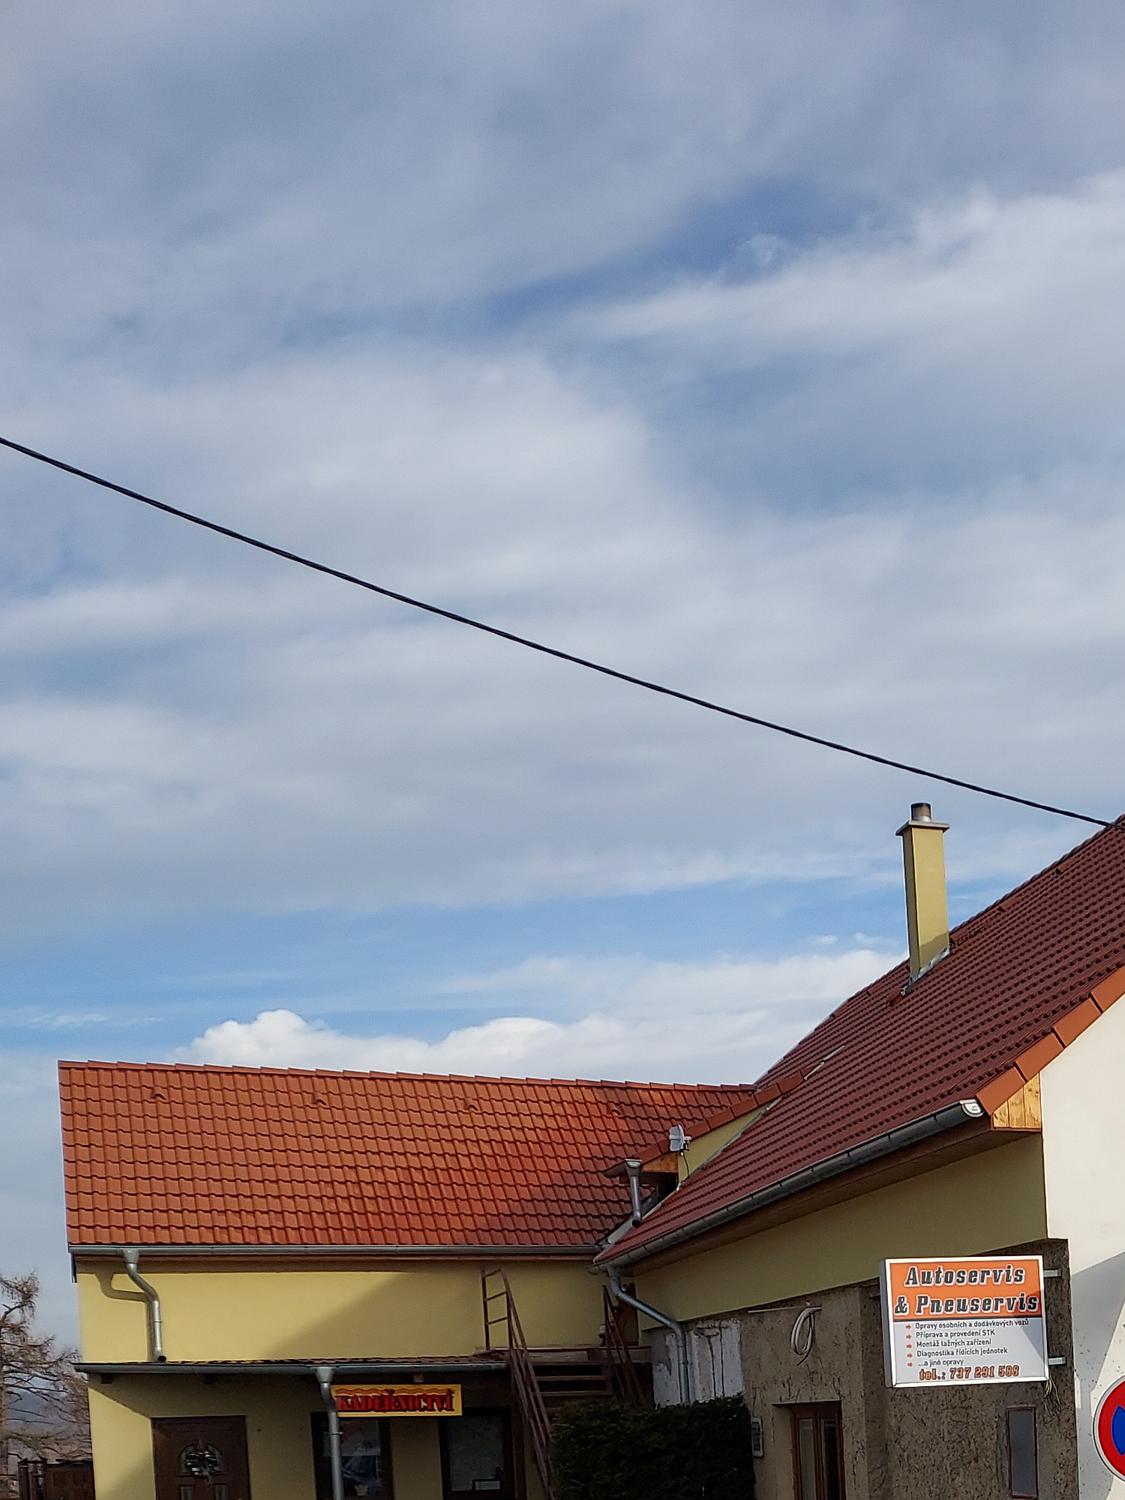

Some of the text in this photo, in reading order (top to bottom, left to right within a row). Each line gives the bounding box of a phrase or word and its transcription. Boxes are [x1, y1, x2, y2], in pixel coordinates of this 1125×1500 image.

[904, 1266, 1025, 1287] Autoservis
[895, 1293, 1039, 1314] & Pneuservis
[917, 1349, 955, 1358] Diagnostika
[980, 1347, 1008, 1356] jednotek
[949, 1366, 971, 1379] 737
[974, 1365, 995, 1378] 291
